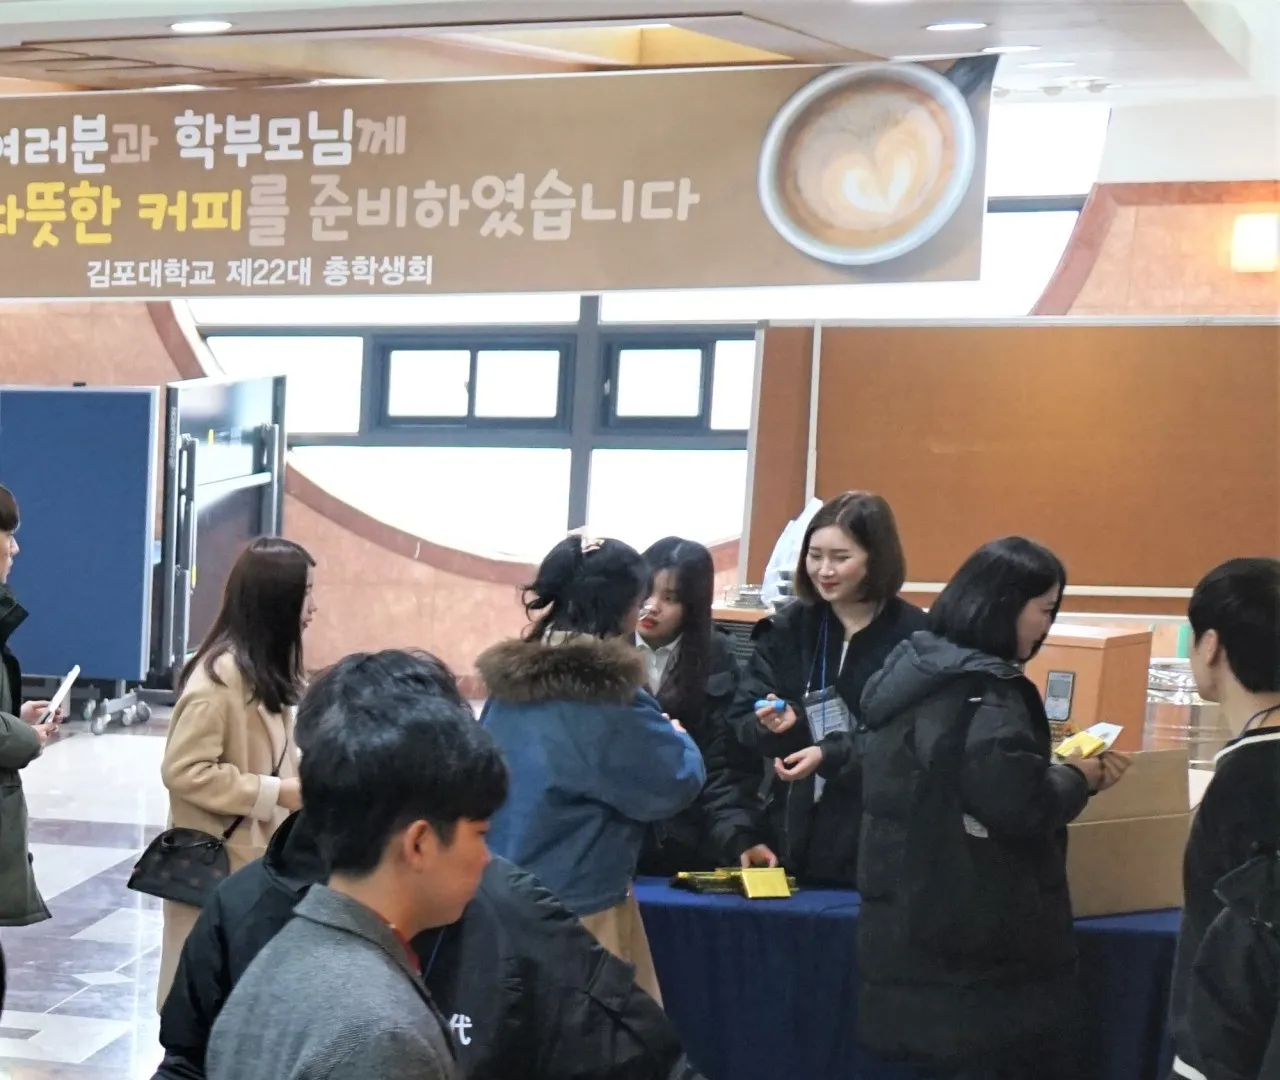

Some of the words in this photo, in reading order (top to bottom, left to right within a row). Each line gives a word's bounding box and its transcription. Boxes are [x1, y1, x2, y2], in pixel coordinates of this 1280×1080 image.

[174, 109, 406, 169] 학부모님께
[138, 174, 289, 246] 커피를
[310, 168, 700, 241] 준비하였습니다
[87, 258, 216, 288] 김포대학교
[227, 257, 311, 287] 제22대
[323, 255, 433, 287] 총학생회
